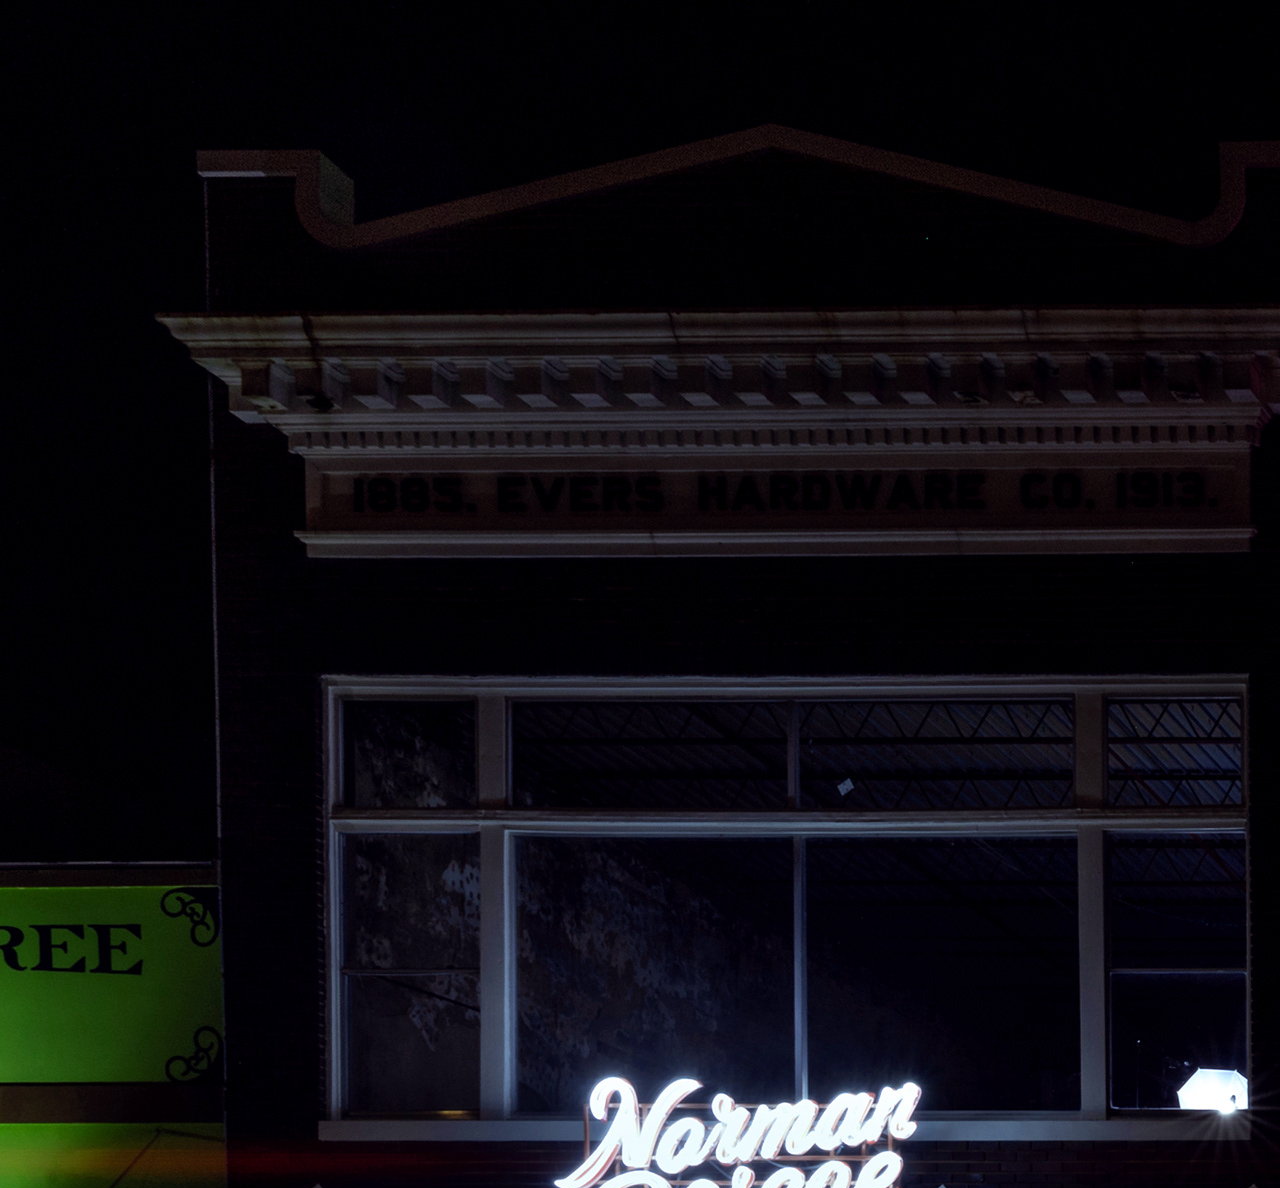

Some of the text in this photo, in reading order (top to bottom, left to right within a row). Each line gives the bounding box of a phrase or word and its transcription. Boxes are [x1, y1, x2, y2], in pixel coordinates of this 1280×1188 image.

[498, 475, 663, 513] EVERS
[698, 473, 986, 512] HARDWARE
[1020, 472, 1096, 509] CO.
[1115, 471, 1219, 508] 1913.
